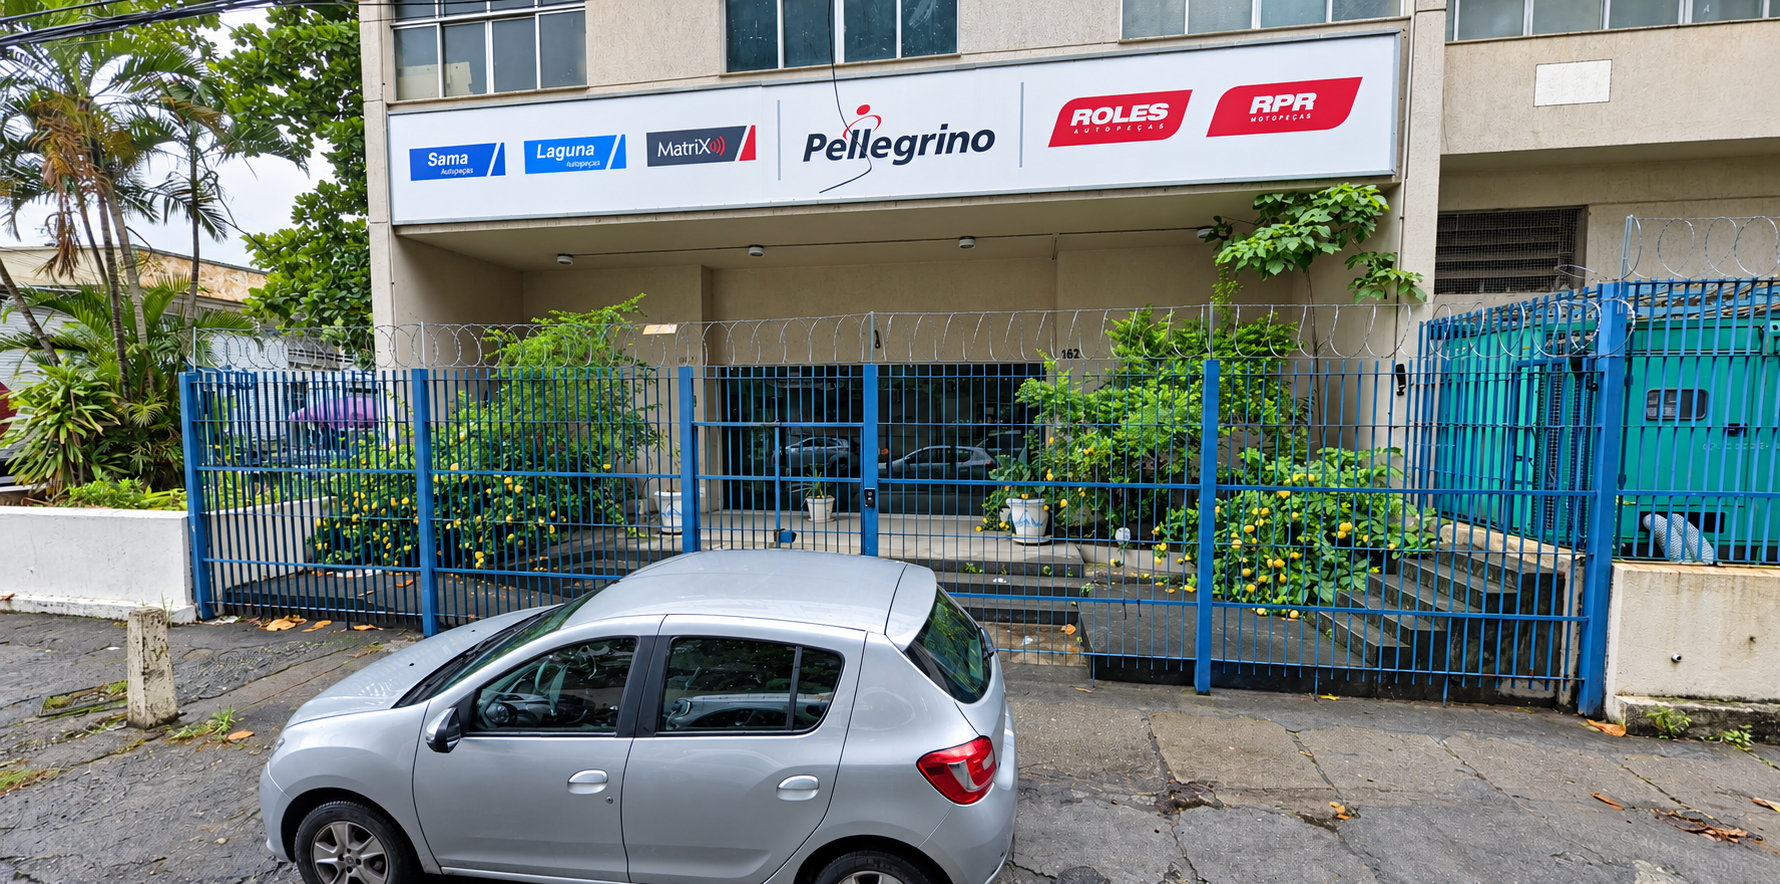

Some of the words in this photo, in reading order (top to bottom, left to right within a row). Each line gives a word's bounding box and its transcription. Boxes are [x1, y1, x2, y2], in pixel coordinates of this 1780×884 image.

[1249, 92, 1317, 114] RPR
[1070, 102, 1170, 126] ROLES
[1250, 113, 1311, 122] MOTOPEÇAS
[1073, 123, 1164, 134] AUTOPEÇAS
[536, 143, 595, 161] Laguna
[803, 123, 996, 166] Pellegrino
[427, 152, 468, 167] Sama
[1062, 348, 1080, 359] 162
